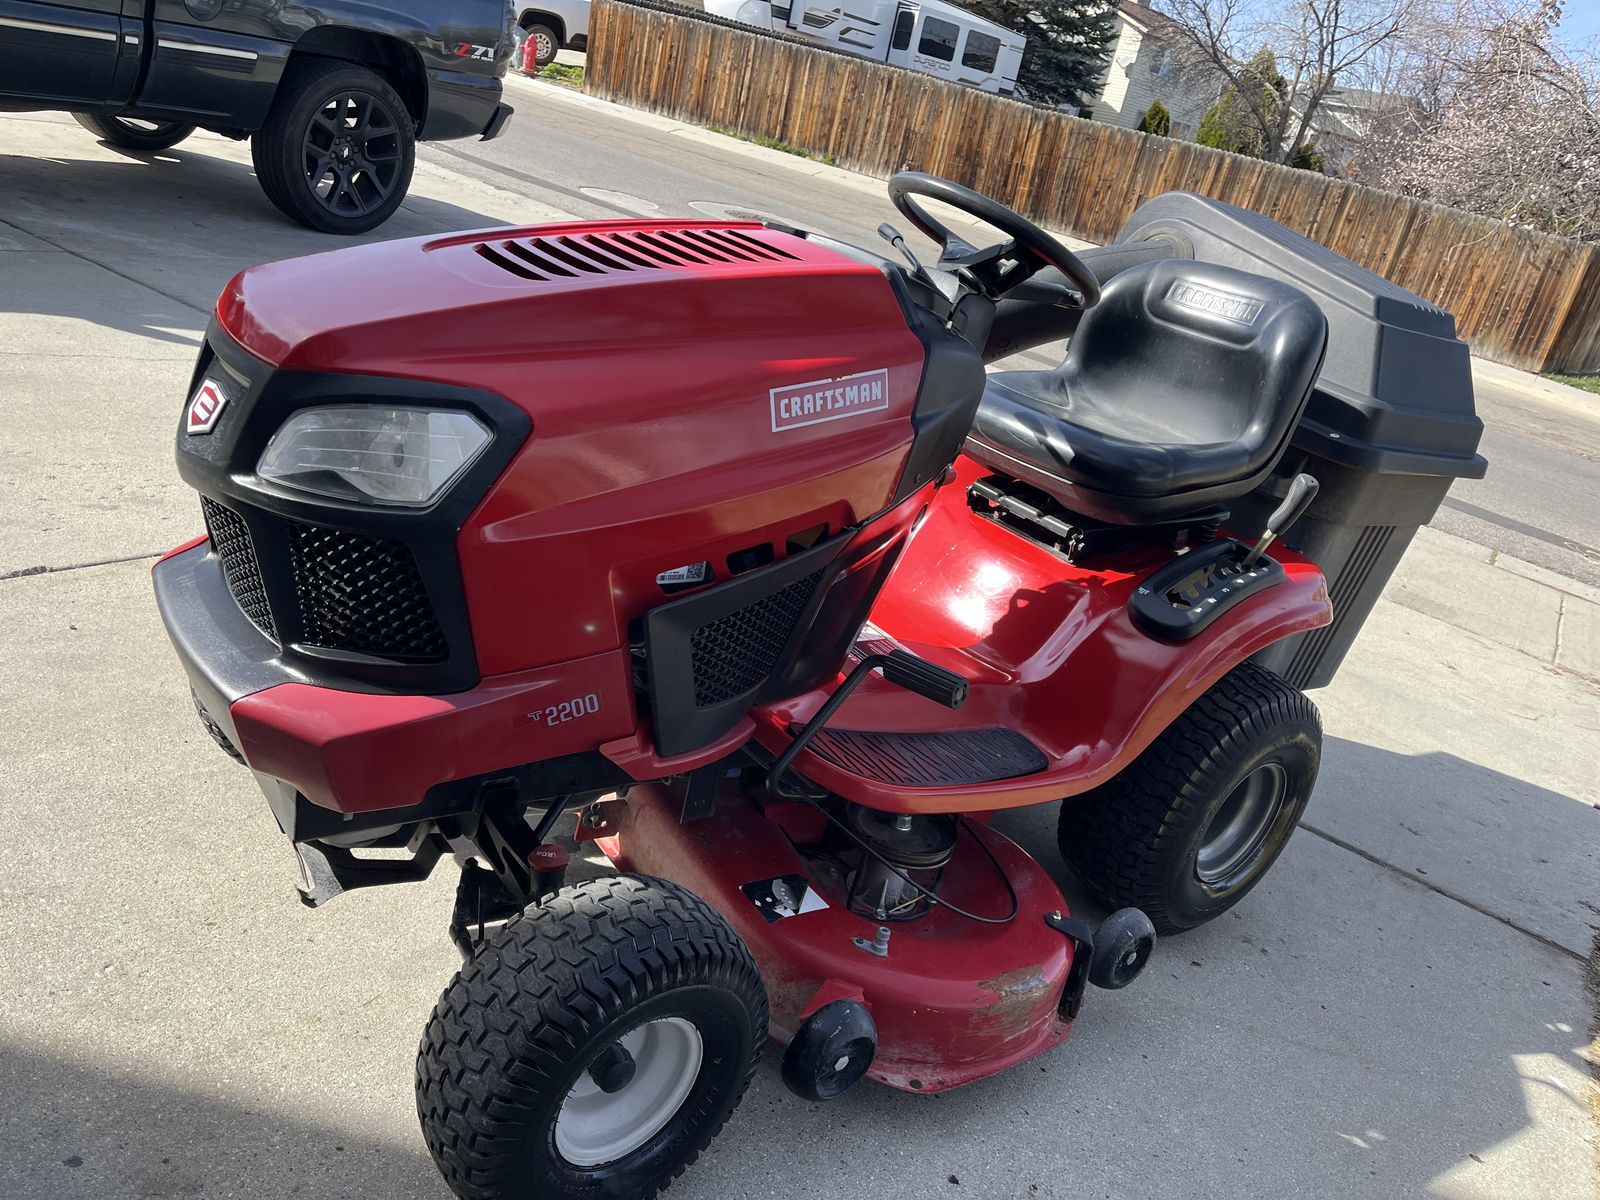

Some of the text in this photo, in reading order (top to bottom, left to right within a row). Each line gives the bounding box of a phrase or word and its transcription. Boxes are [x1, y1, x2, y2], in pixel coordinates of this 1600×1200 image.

[456, 42, 495, 58] Z71
[1173, 284, 1258, 321] CRAFTSMAN
[780, 380, 882, 419] CRAFTSMAN
